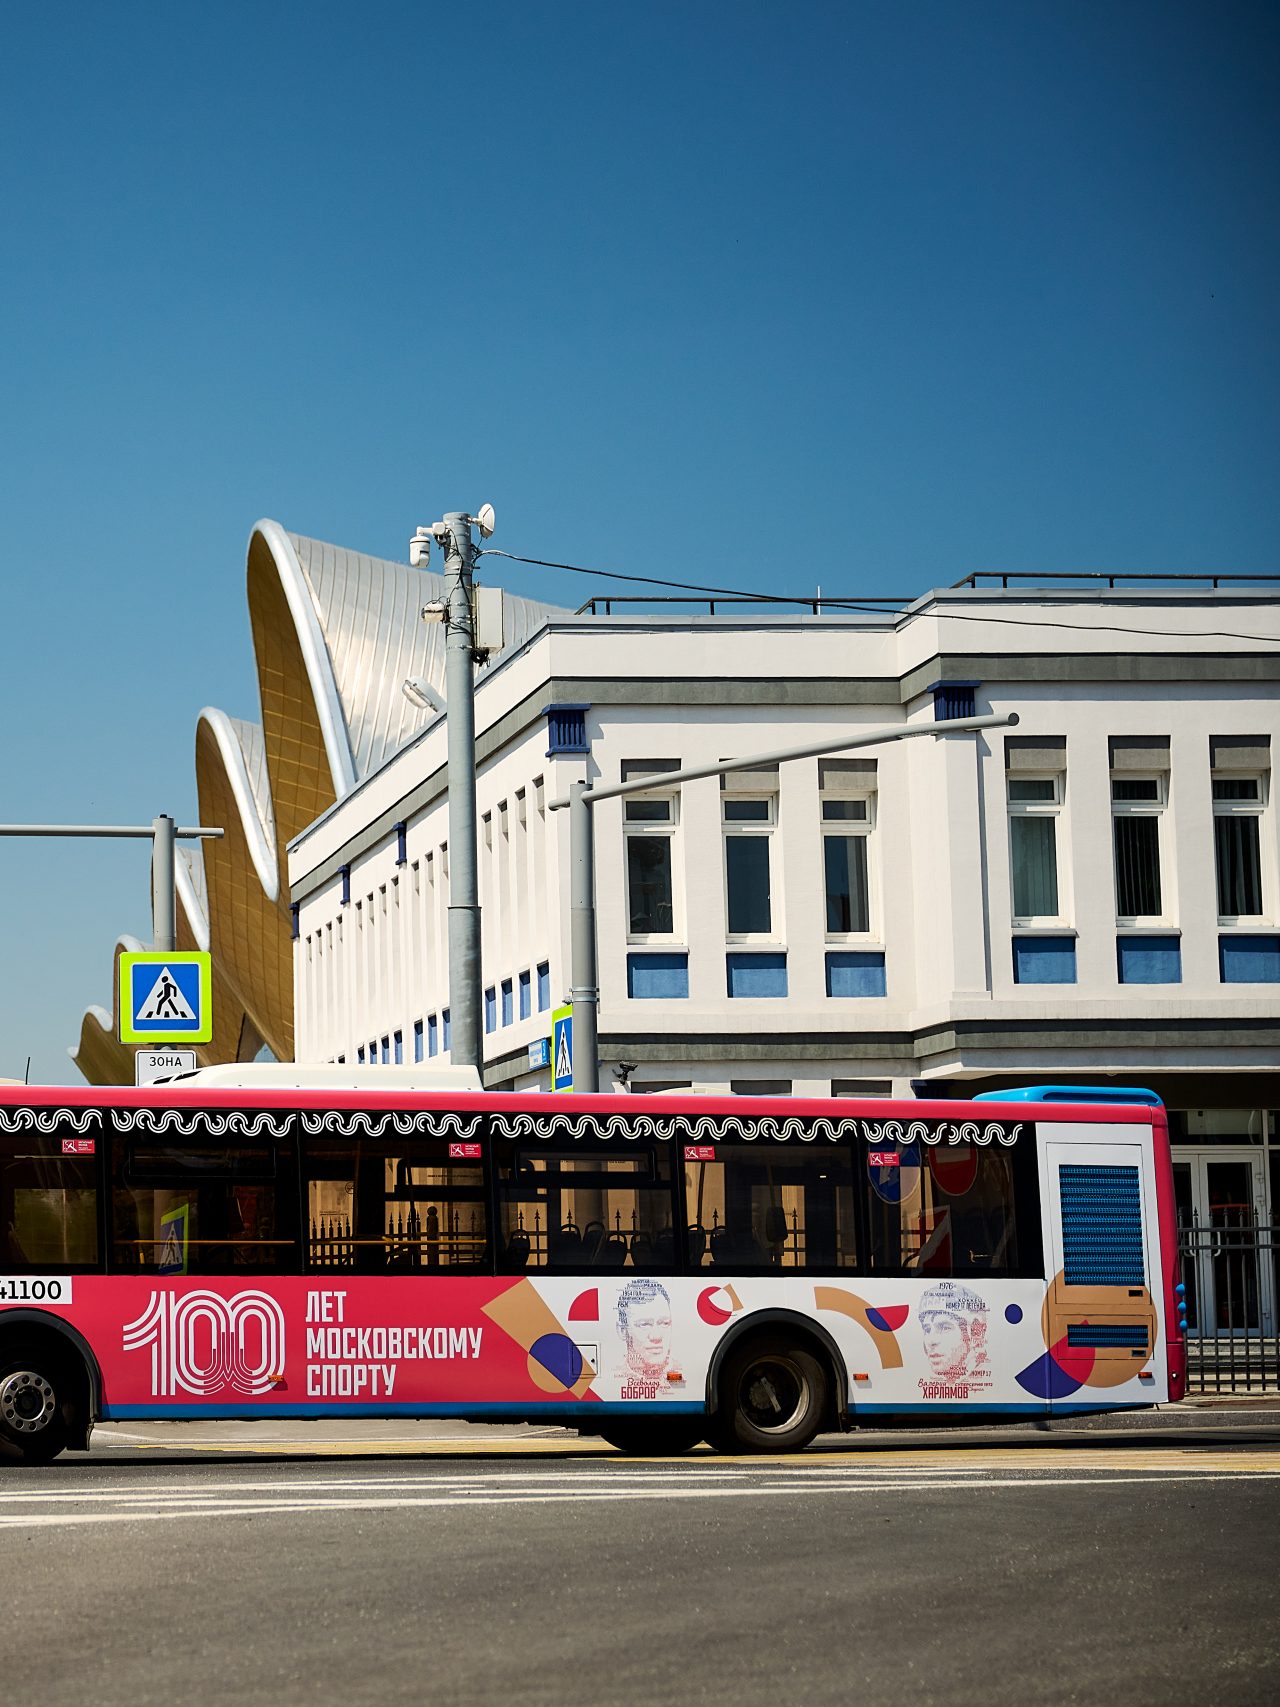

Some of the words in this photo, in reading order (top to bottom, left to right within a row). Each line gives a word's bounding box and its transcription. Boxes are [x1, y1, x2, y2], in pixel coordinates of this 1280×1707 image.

[149, 1056, 182, 1067] ЗОНА
[305, 1291, 347, 1323] ЛЕТ
[123, 1290, 285, 1396] 100
[306, 1327, 483, 1359] МОСКОВСКОМУ
[307, 1364, 397, 1396] СПОРТУ
[627, 1377, 661, 1390] Всеволод
[621, 1386, 656, 1400] БОБРОВ
[922, 1386, 969, 1399] ХАРЛАМОВ
